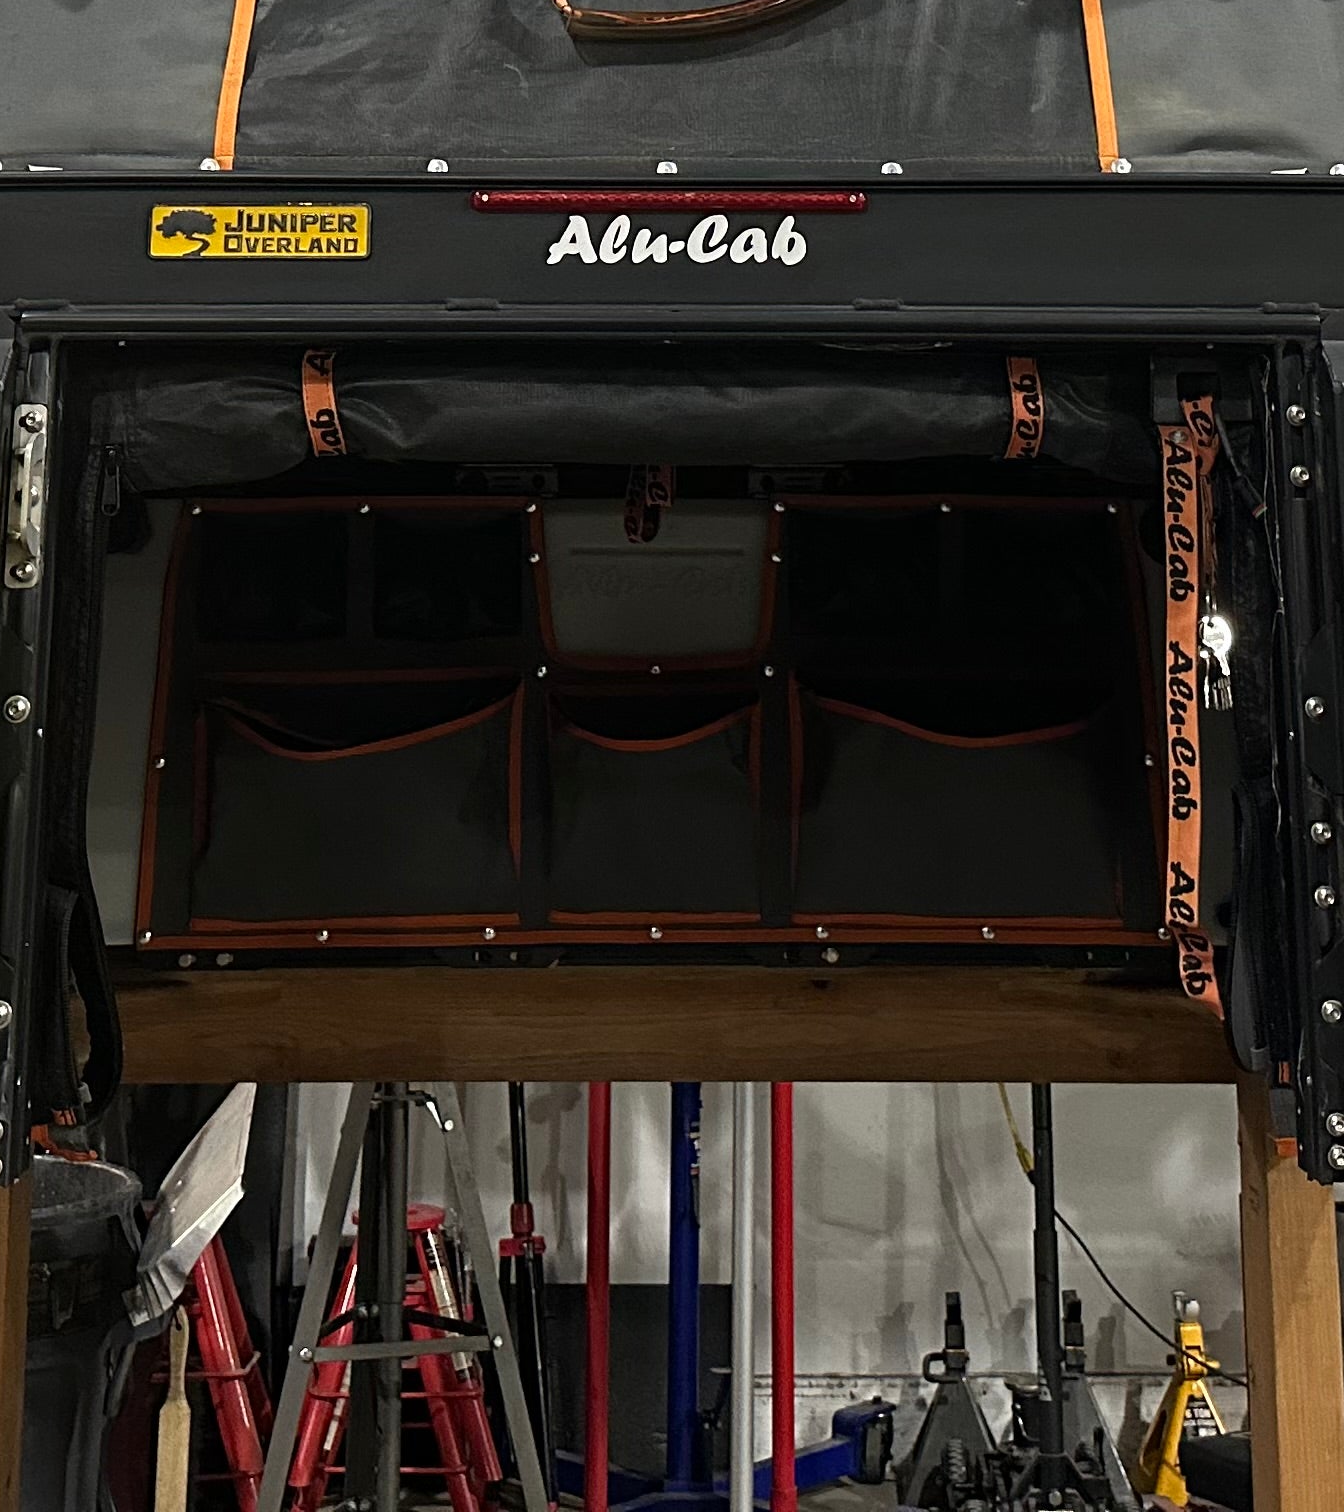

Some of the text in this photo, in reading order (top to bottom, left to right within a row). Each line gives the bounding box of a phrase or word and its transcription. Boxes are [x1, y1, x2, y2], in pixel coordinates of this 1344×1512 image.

[223, 209, 359, 236] JUNIPER
[223, 235, 360, 254] OVERLAND
[546, 214, 808, 266] Alu-Cab
[1165, 438, 1198, 603] Alu-Cab
[1168, 639, 1198, 822] Alu-Cab
